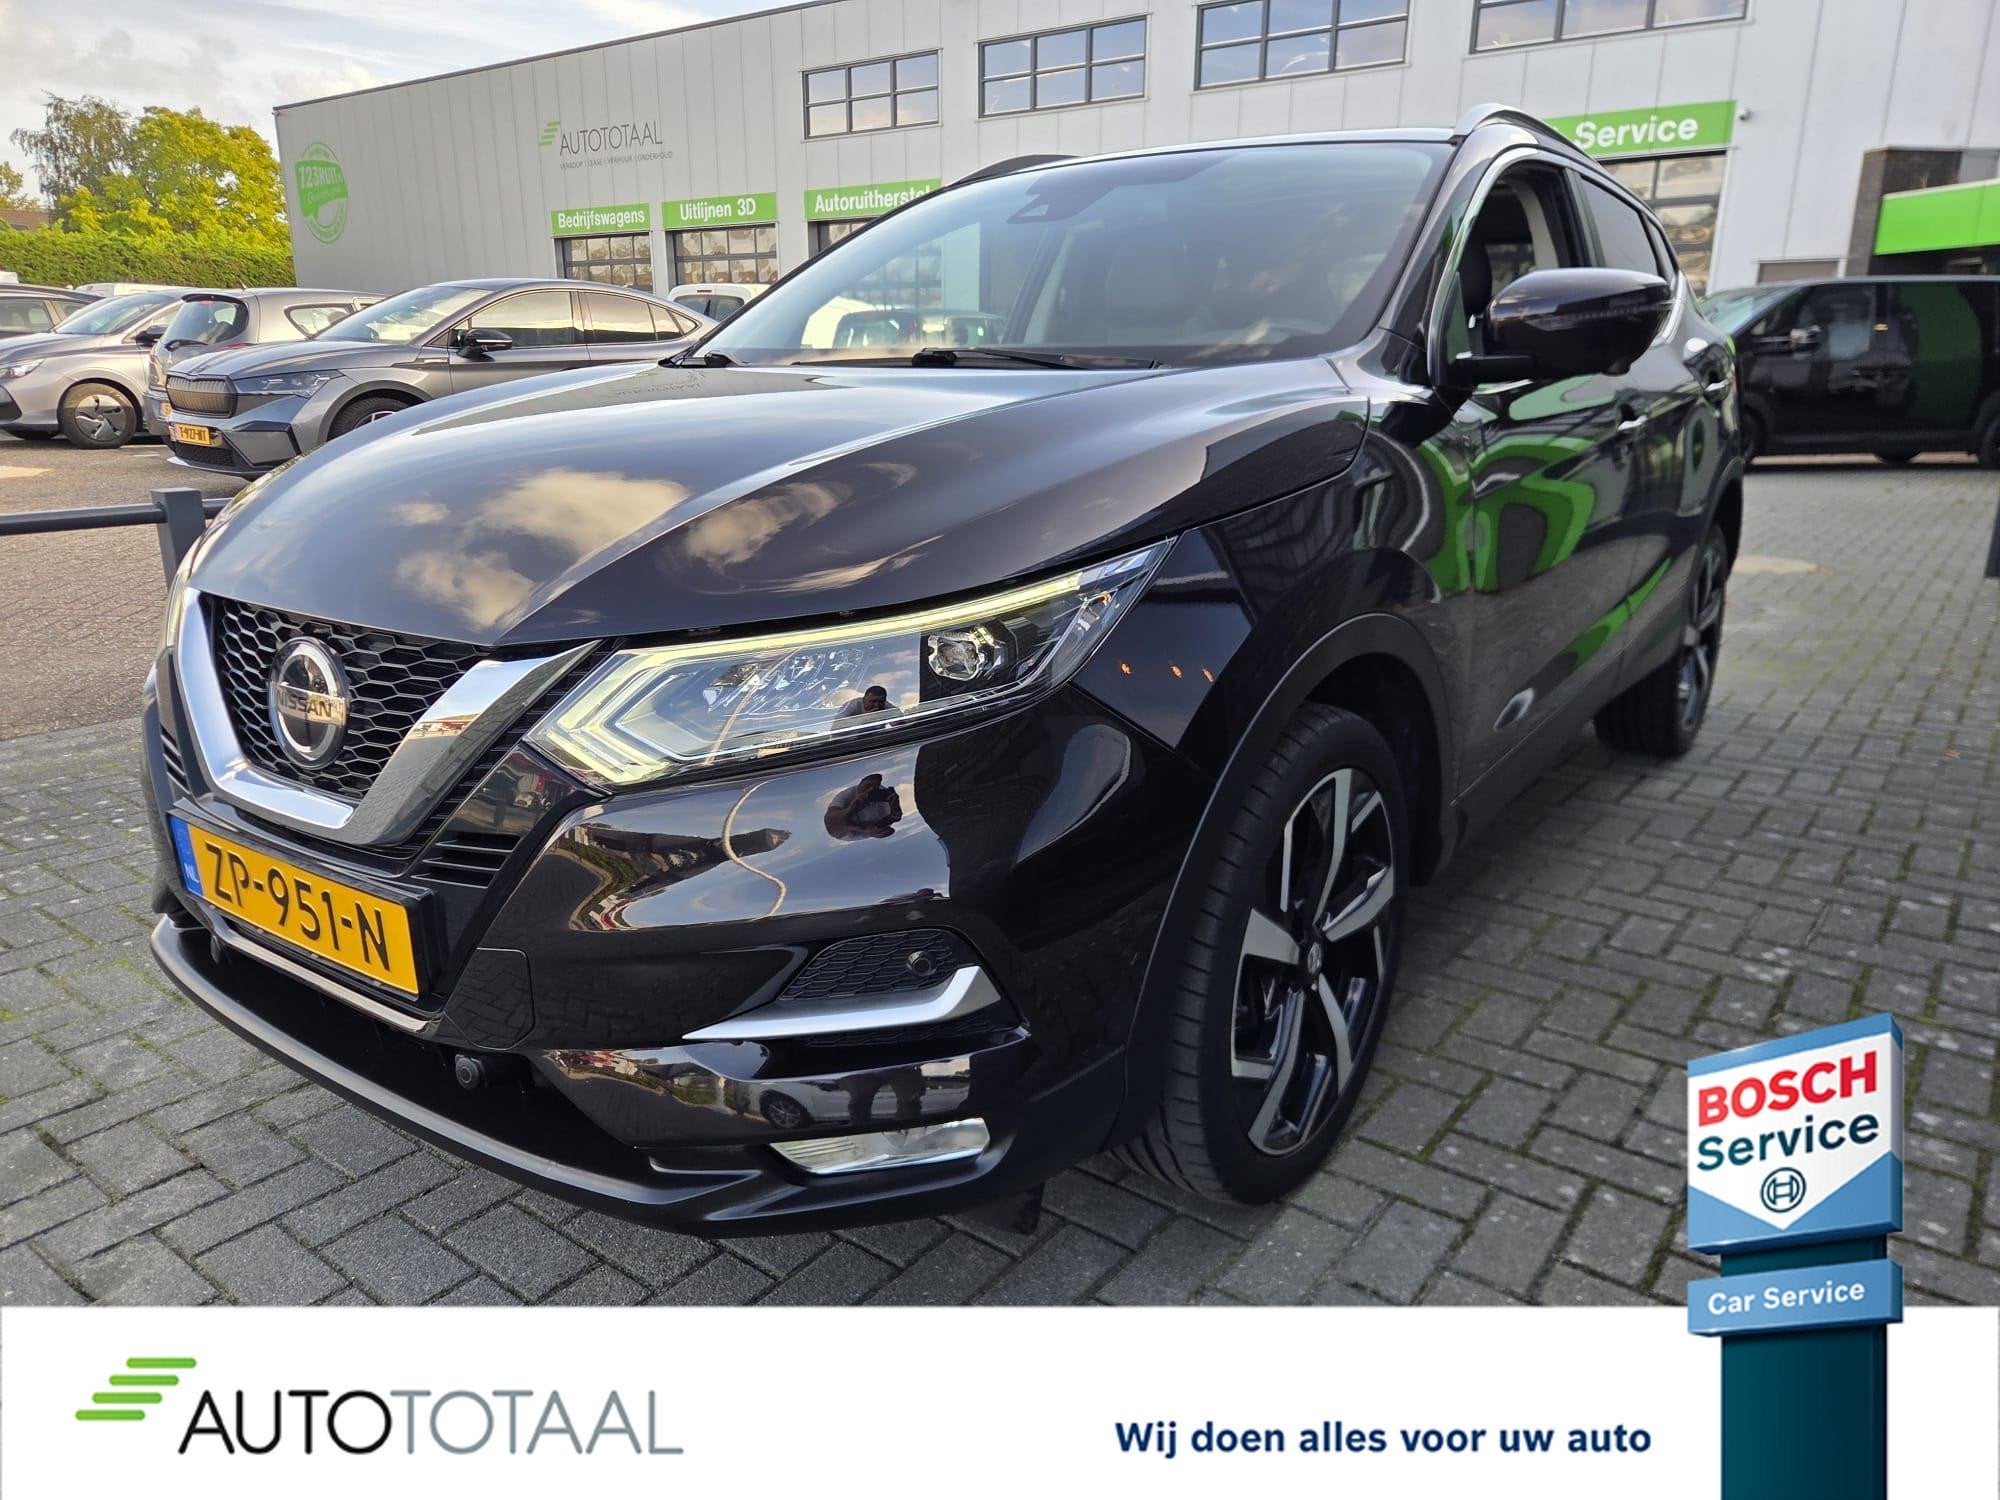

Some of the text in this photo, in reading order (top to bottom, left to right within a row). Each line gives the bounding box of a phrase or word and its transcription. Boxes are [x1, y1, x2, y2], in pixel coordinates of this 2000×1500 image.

[560, 120, 663, 156] AUTOTOTAAL
[1575, 115, 1698, 149] Service
[558, 210, 645, 229] Bedrijfswagens
[679, 197, 756, 222] Uitlijnen 3D
[277, 688, 332, 718] NISSAN
[184, 862, 200, 884] NL
[205, 840, 390, 972] ZP-951-N
